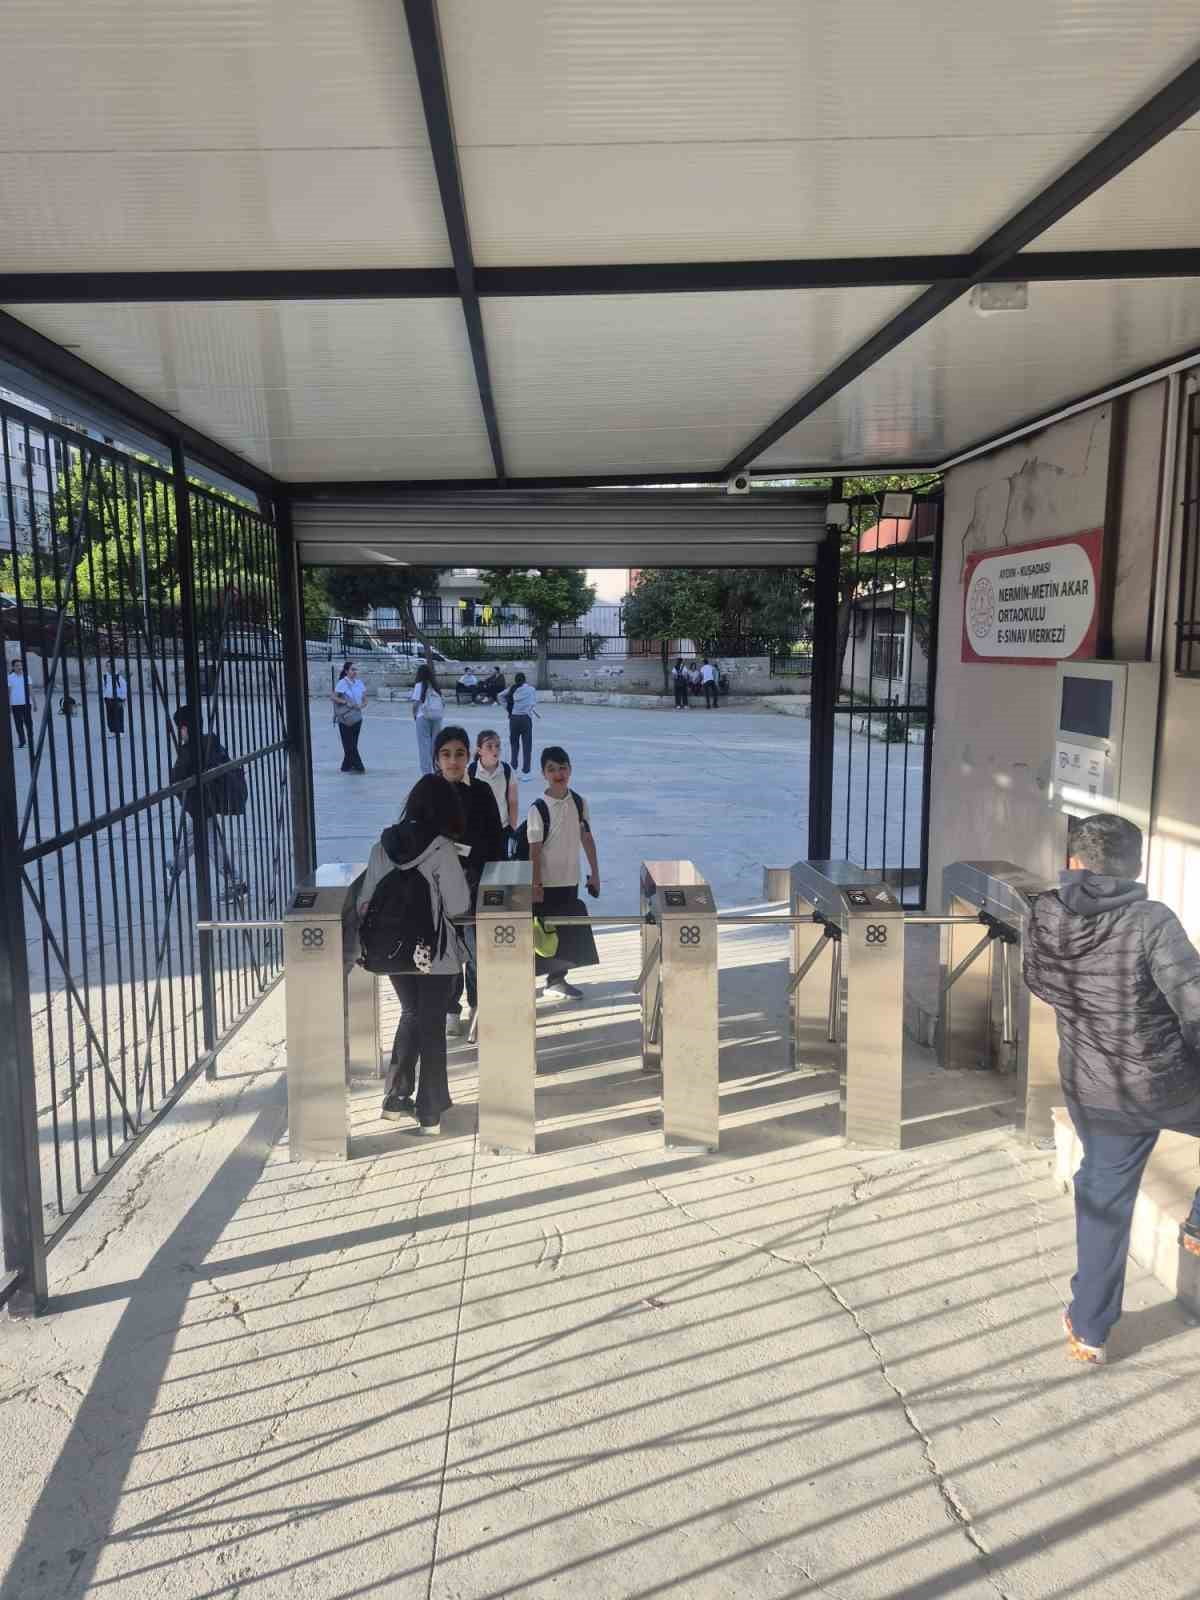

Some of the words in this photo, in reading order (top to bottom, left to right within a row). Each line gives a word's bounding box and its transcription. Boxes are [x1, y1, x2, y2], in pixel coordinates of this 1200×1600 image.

[1060, 579, 1089, 596] AKAR
[998, 606, 1046, 623] ORTAOKULU
[997, 629, 1026, 644] E-SINAV
[1027, 625, 1066, 643] MERKEZİ
